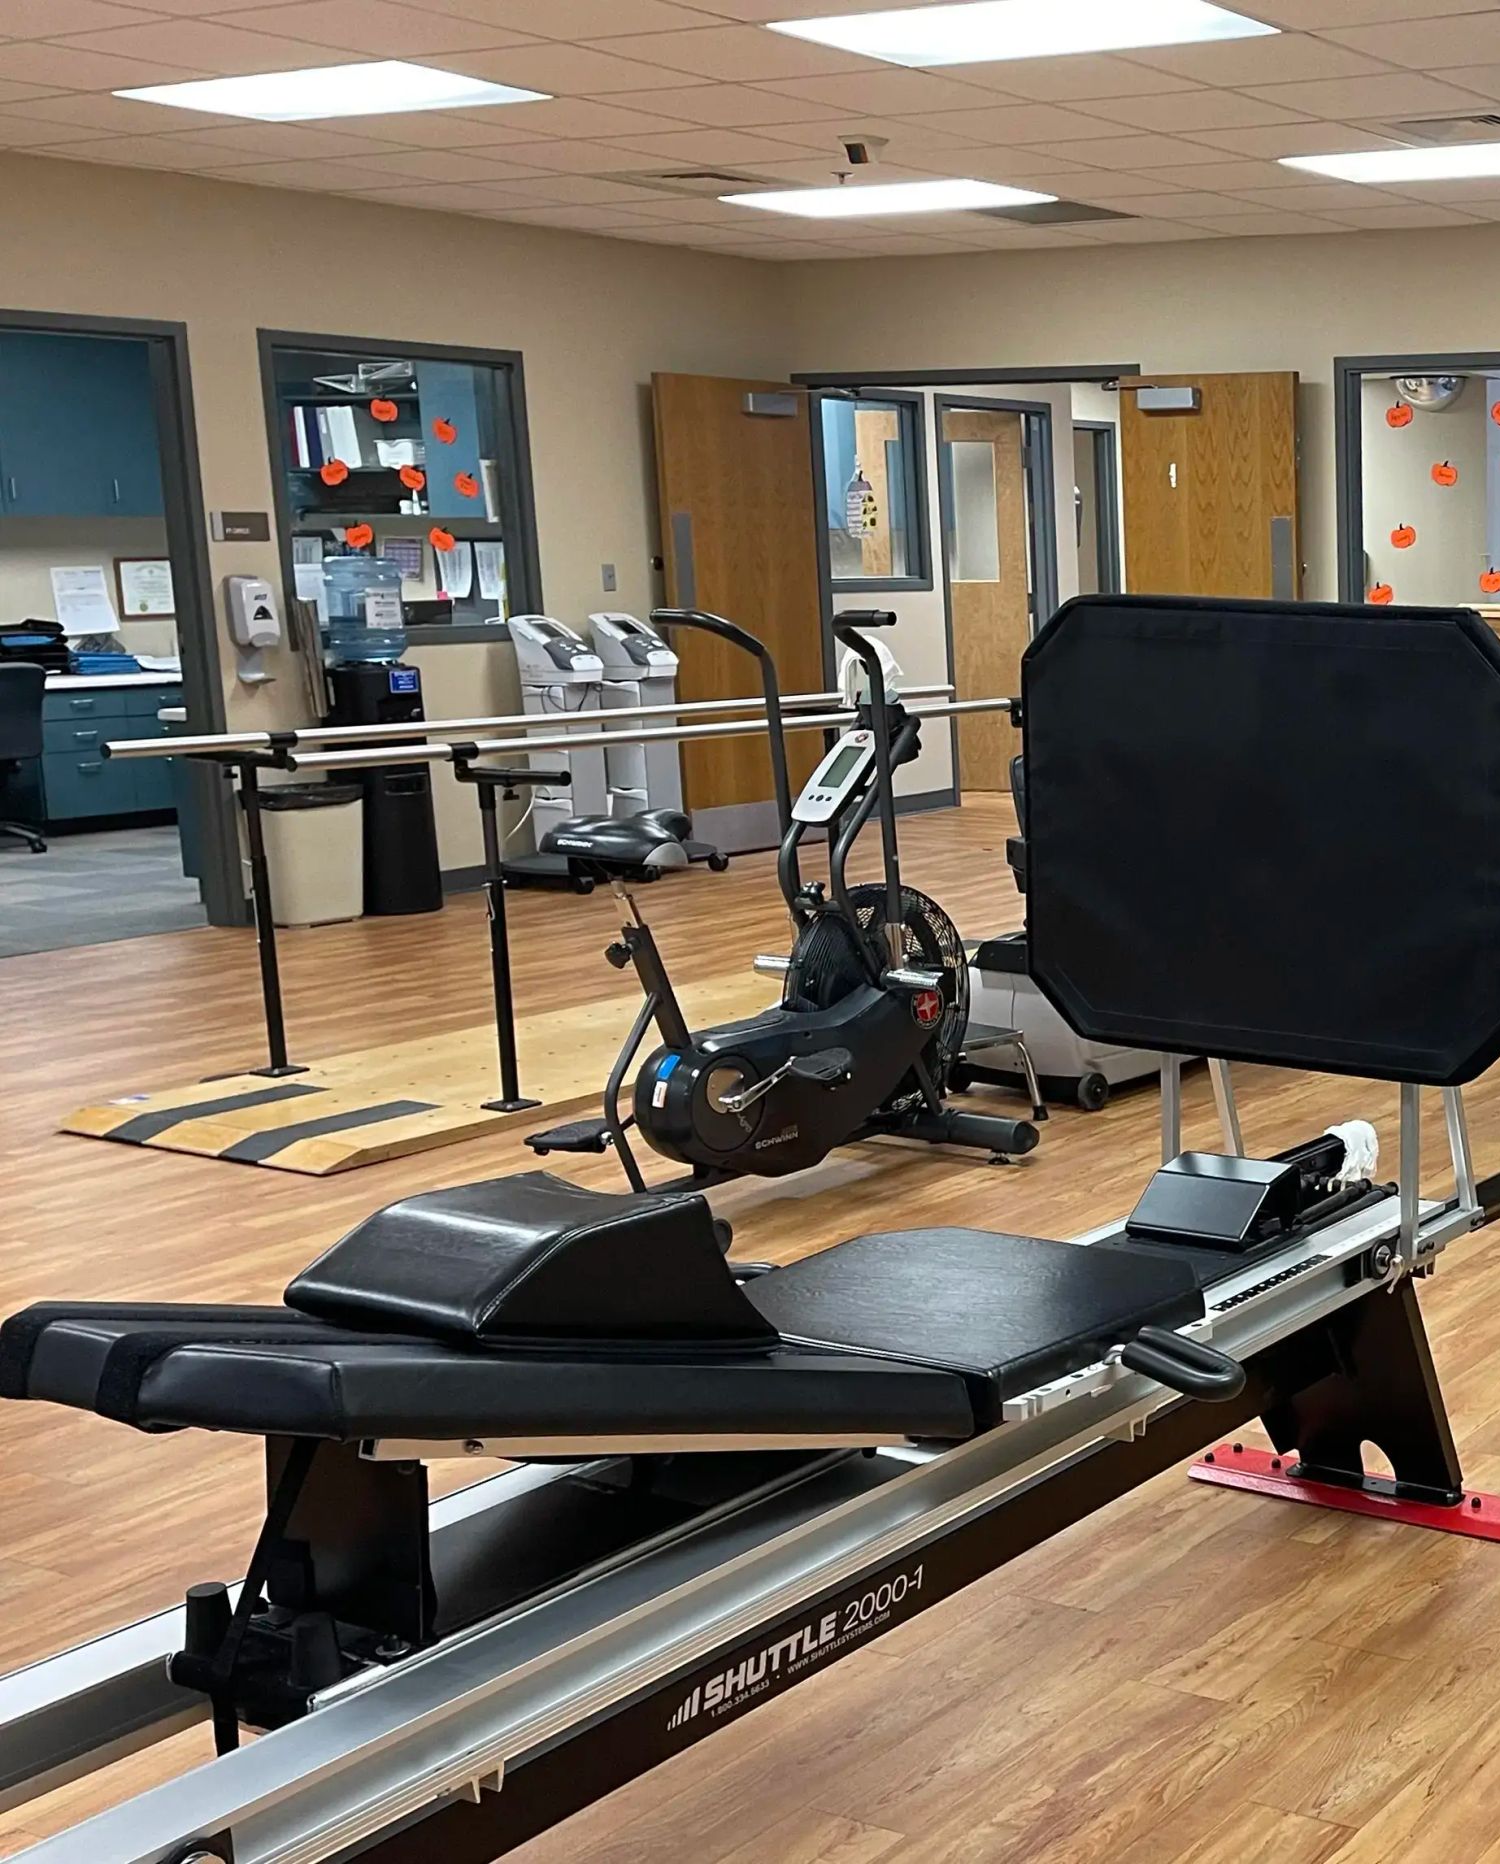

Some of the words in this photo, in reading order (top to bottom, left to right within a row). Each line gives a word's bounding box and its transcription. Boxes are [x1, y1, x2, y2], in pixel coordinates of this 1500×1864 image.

[755, 1131, 799, 1150] SCHWINN
[703, 1611, 837, 1711] SHUTTLE
[843, 1564, 924, 1632] 2000-1
[787, 1610, 891, 1674] WWW.SHUTTLESYSTEMS.COM
